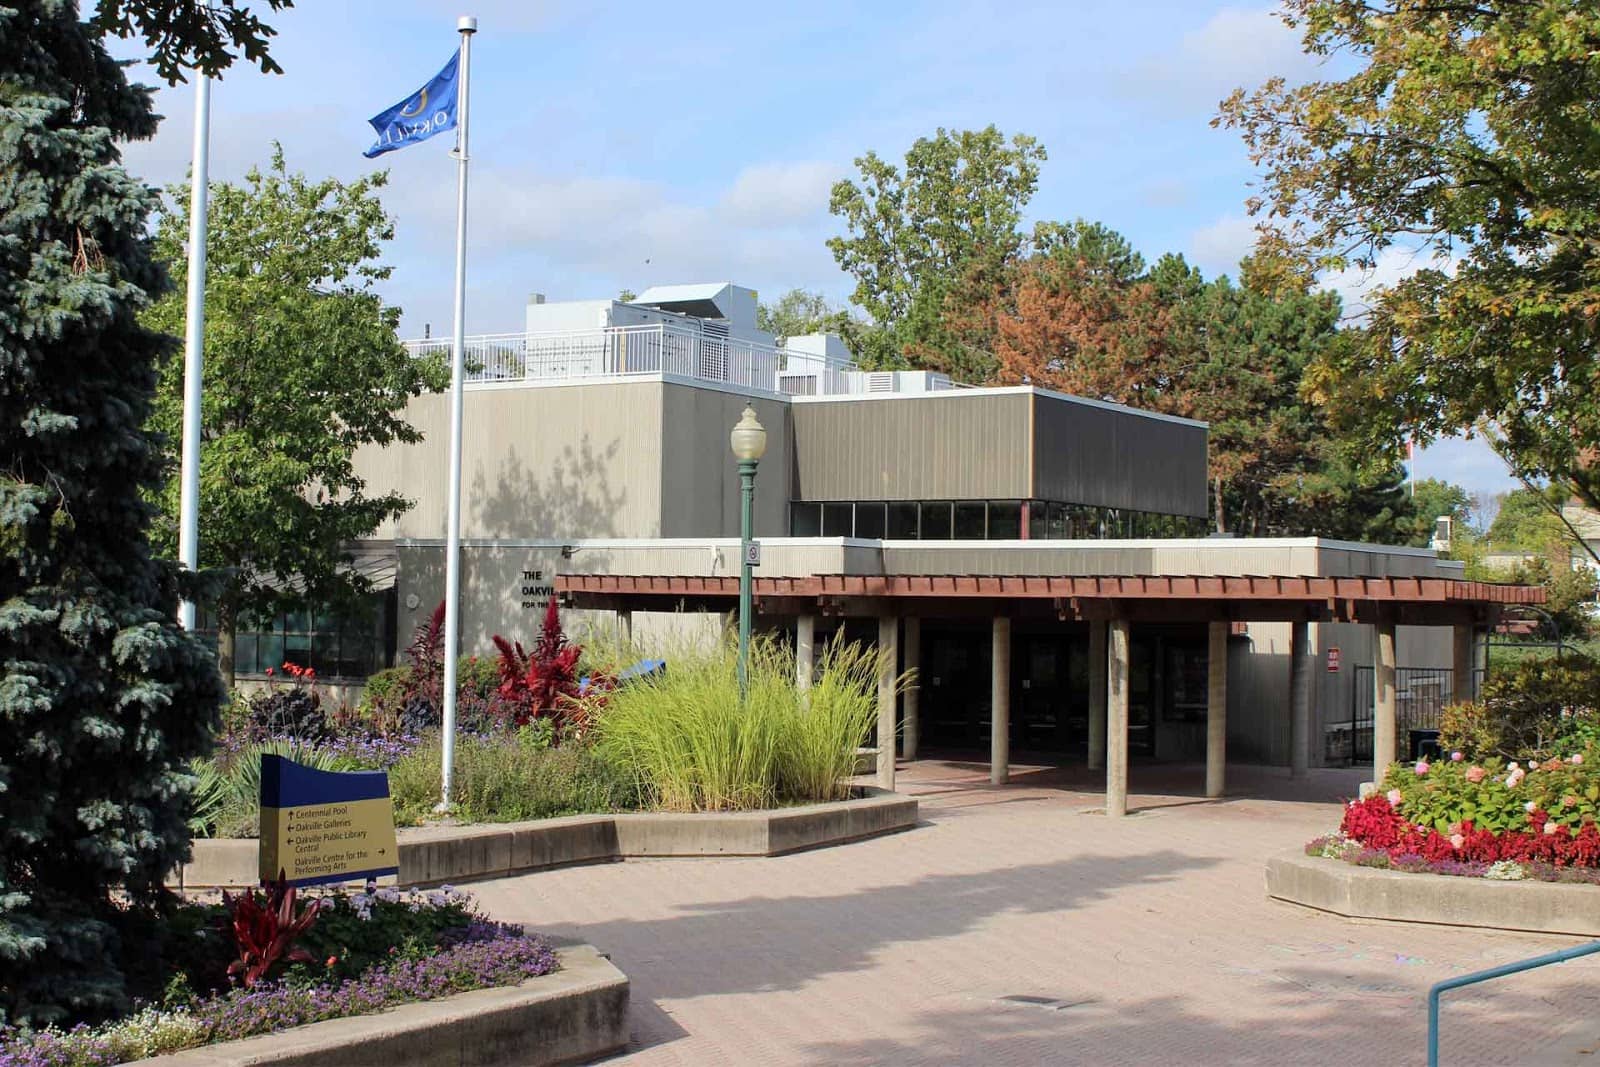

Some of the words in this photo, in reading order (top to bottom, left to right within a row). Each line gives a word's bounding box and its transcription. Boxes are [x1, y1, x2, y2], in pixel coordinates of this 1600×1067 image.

[523, 571, 542, 580] THE
[295, 808, 331, 819] Centennial
[333, 806, 348, 814] Pool
[295, 822, 322, 832] Oakville
[324, 820, 351, 830] Galleries
[295, 836, 322, 845] Oakville
[323, 834, 343, 842] Public
[344, 831, 367, 841] Library
[295, 843, 320, 853] Central
[295, 856, 321, 866] Oakville
[322, 853, 345, 863] Centre
[346, 851, 356, 861] for
[357, 850, 368, 859] the
[295, 864, 331, 875] Performing
[333, 862, 347, 870] Arts
